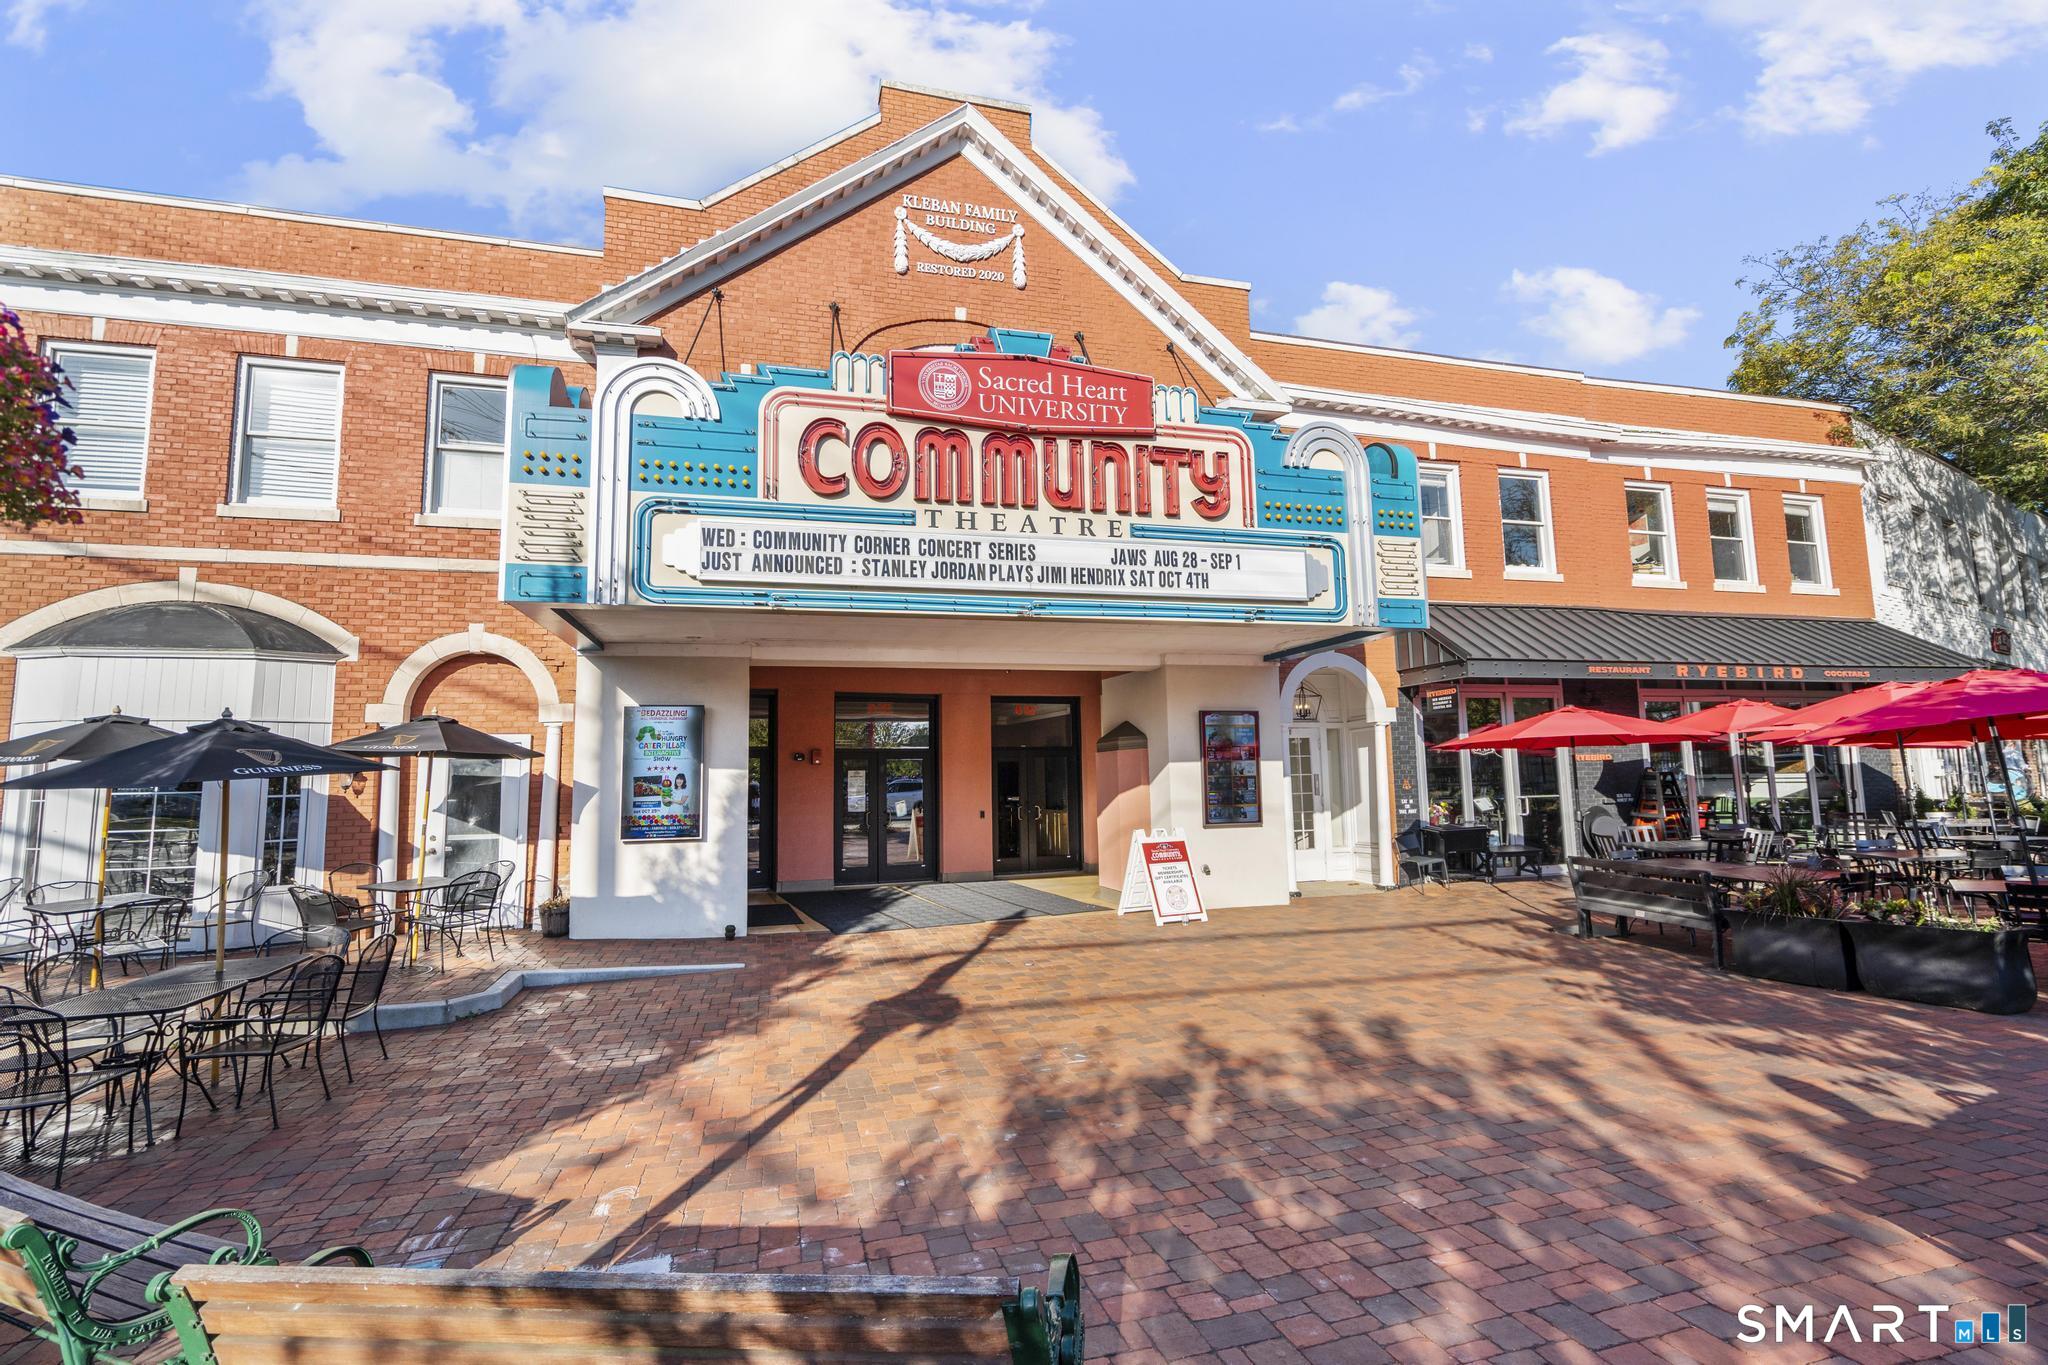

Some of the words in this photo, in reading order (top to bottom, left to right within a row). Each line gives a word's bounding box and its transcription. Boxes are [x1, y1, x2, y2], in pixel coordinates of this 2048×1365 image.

[902, 194, 961, 215] KLEBAN
[964, 203, 1018, 223] FAMILY
[925, 214, 996, 234] BUILDING
[916, 262, 976, 278] RESTORED
[978, 269, 1005, 282] 2020
[978, 366, 1053, 396] Sacred
[1062, 374, 1127, 402] Heart
[979, 393, 1128, 425] UNIVERSITY
[924, 509, 1123, 538] THEATRE
[753, 530, 847, 552] COMMUNITY
[854, 535, 910, 556] CORNER
[918, 538, 981, 559] CONCERT
[988, 542, 1036, 562] SERIES
[701, 551, 742, 571] JUST
[861, 558, 927, 578] STANLEY
[931, 561, 986, 581] JORDAN
[989, 563, 1034, 583] PLAYS
[1037, 565, 1067, 584] JIMI
[1071, 567, 1126, 586] HENDRIX
[1130, 569, 1155, 588] SAT
[1159, 570, 1182, 588] OCT
[1186, 572, 1209, 589] 4TH
[1111, 548, 1147, 567] JAWS
[1154, 550, 1178, 568] AUG
[1182, 551, 1198, 569] 28
[1210, 553, 1232, 570] SEP
[1235, 554, 1241, 570] 1
[1588, 665, 1651, 674] RESTAURANT
[1677, 664, 1804, 679] RYEBIRD
[1823, 669, 1871, 678] COCKTAILS
[233, 764, 322, 775] GUINNESS
[41, 1253, 71, 1301] DONATED
[68, 1310, 87, 1325] BY
